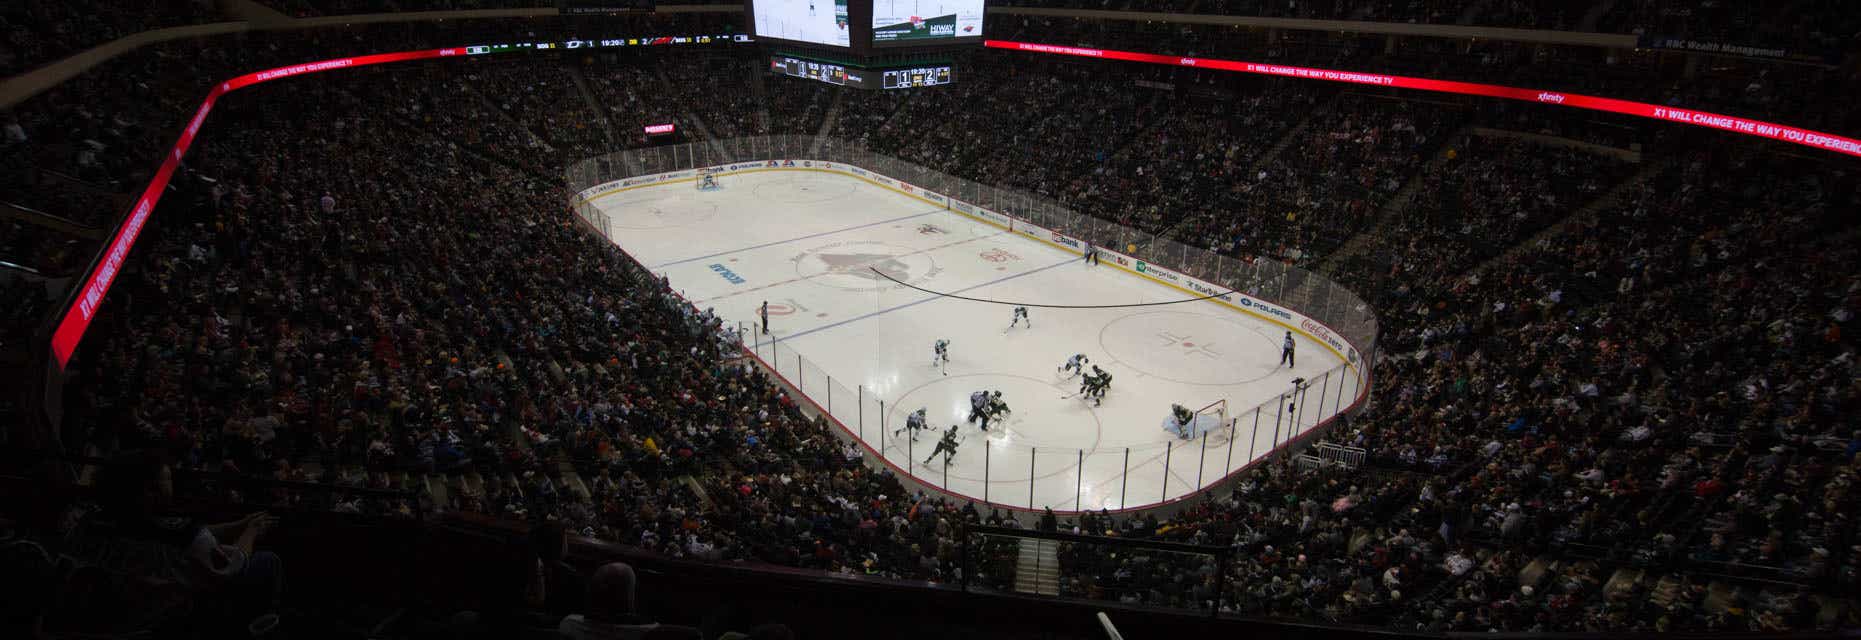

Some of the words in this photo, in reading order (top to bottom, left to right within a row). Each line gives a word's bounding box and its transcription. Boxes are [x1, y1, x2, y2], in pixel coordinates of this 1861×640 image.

[930, 24, 954, 32] HIWAY
[1666, 39, 1685, 48] RBC
[1688, 41, 1719, 51] Wealth
[1722, 44, 1785, 57] Management
[902, 73, 907, 82] 1
[927, 70, 933, 80] 2
[1255, 65, 1269, 73] WILL
[1270, 66, 1295, 75] CHANGE
[1309, 70, 1323, 78] WAY
[1324, 71, 1339, 79] YOU
[1340, 73, 1382, 84] EXPERIENCE
[1383, 77, 1393, 85] TV
[1538, 92, 1564, 104] xfinity
[1654, 108, 1666, 118] X1
[1668, 110, 1692, 122] WILL
[1693, 114, 1733, 129] CHANGE
[1735, 120, 1755, 132] THE
[1756, 124, 1782, 138] WAY
[1782, 128, 1804, 142] YOU
[1253, 302, 1291, 320] POLARIS
